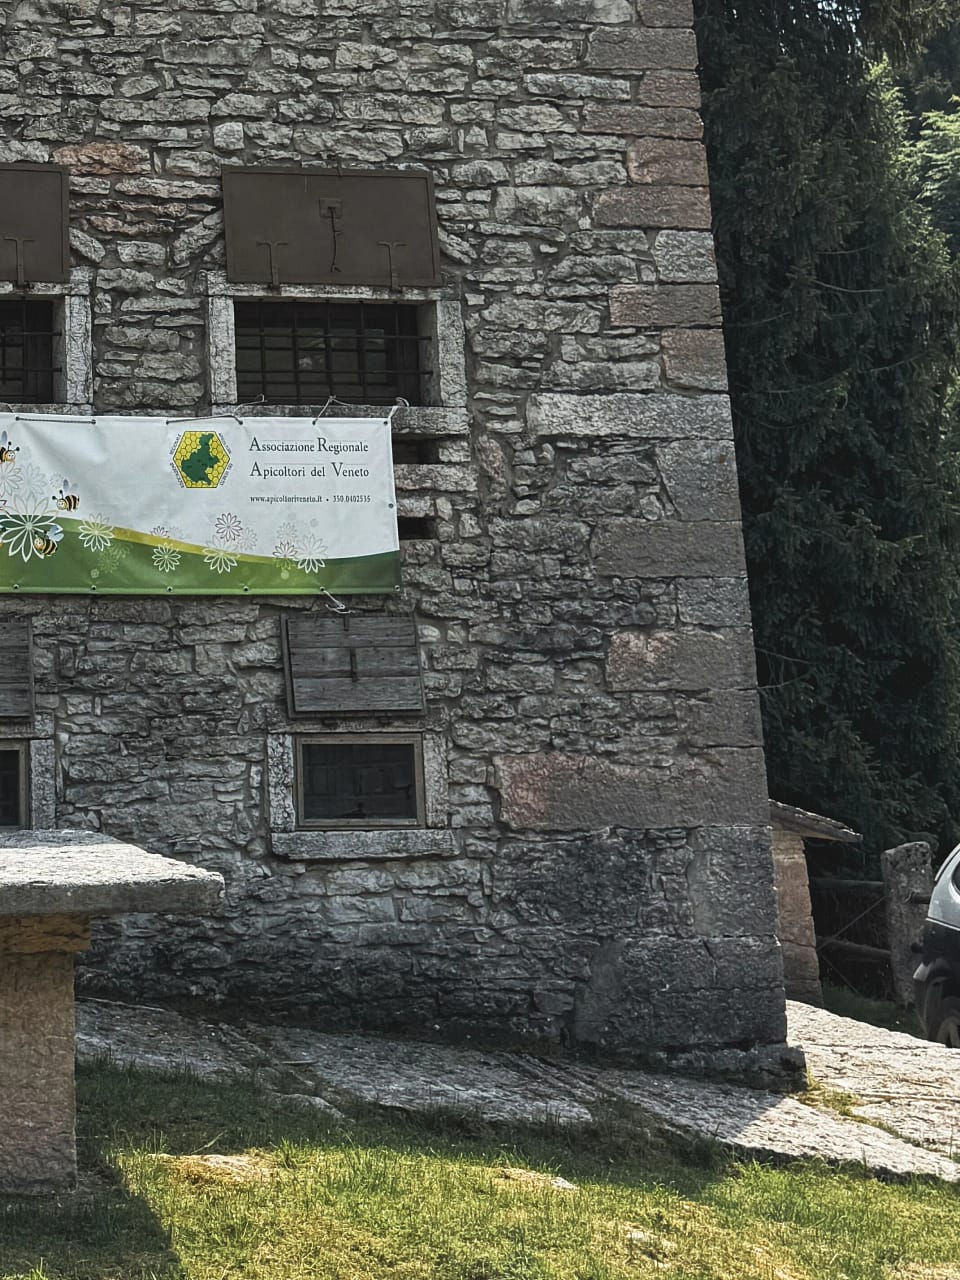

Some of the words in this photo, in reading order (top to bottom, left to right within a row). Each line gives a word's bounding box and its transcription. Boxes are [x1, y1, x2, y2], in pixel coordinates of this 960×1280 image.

[249, 436, 315, 452] Associazione
[317, 437, 369, 455] Regionale
[250, 461, 305, 479] Apicoltori
[310, 466, 326, 477] del
[331, 461, 370, 477] Veneto
[249, 494, 323, 504] www.apicoltoriveneto.it
